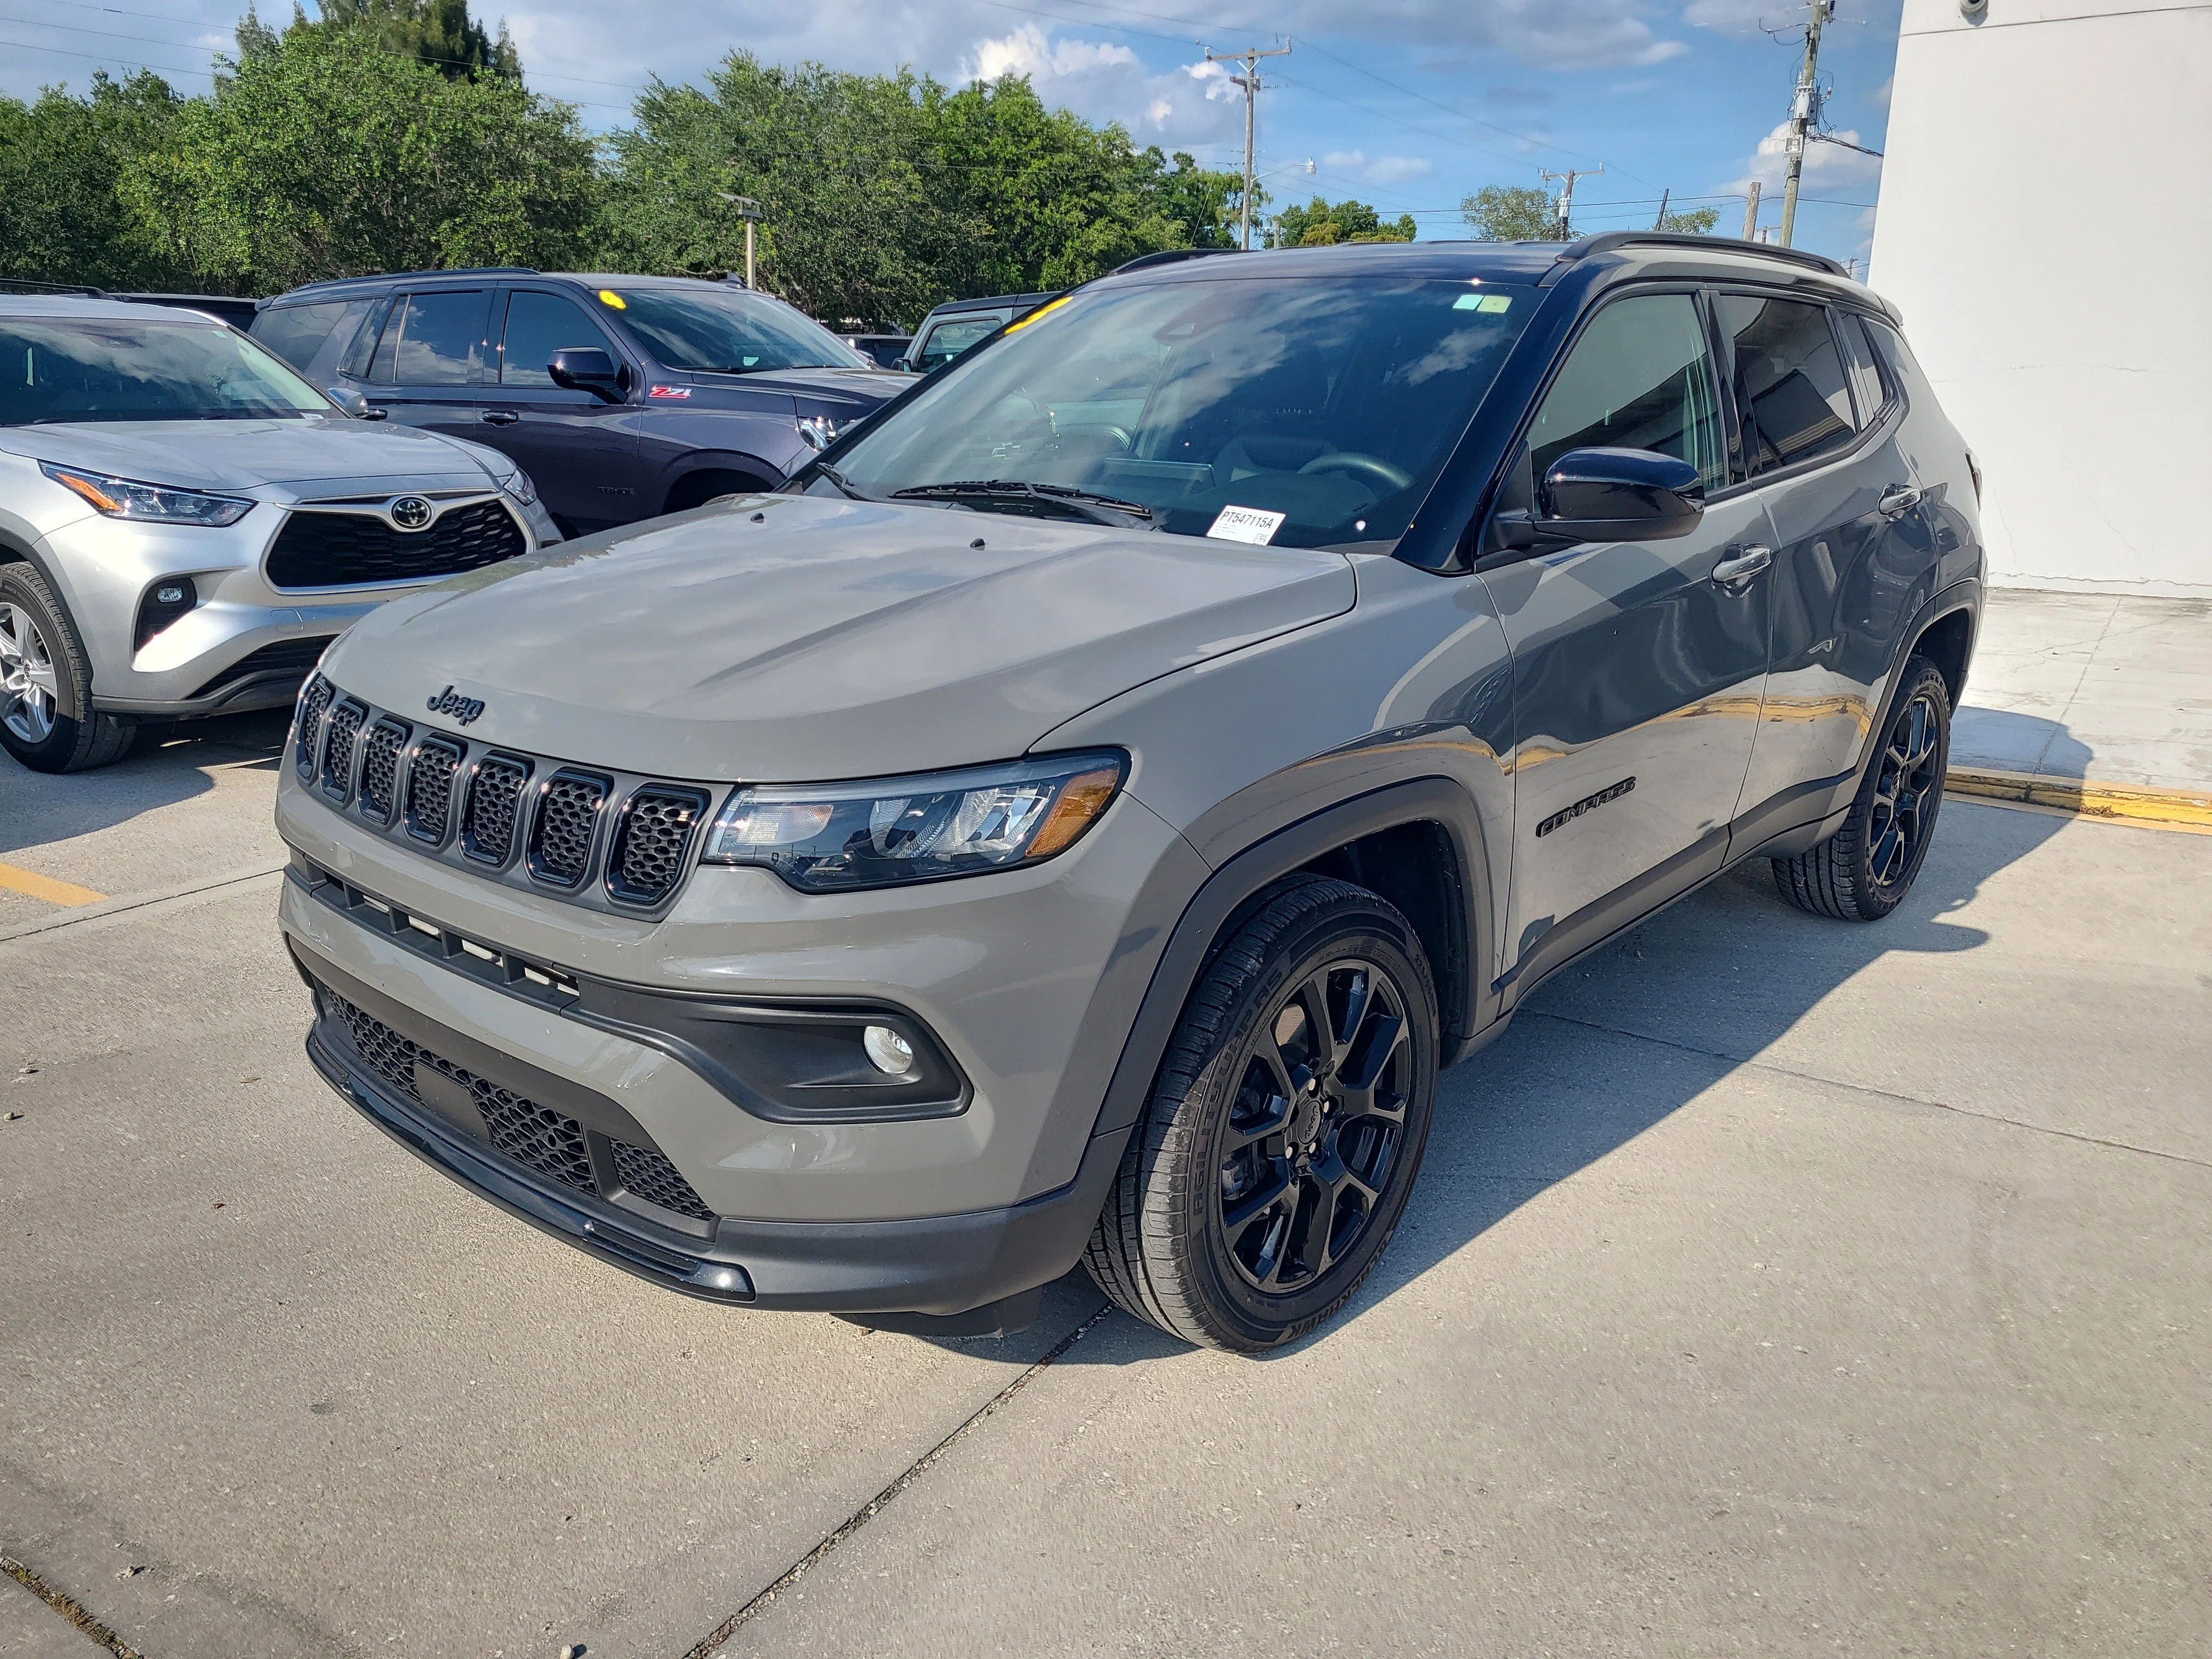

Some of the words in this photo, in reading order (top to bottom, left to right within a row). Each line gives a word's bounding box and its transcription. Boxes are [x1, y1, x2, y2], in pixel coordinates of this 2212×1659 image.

[597, 486, 636, 495] TAHOE
[1220, 511, 1274, 529] PT547115A
[426, 685, 486, 726] Jeep
[1535, 776, 1637, 838] COMPASS
[1193, 1079, 1224, 1216] AGILITY
[1253, 968, 1284, 1012] AS
[1304, 1105, 1319, 1139] Jeep
